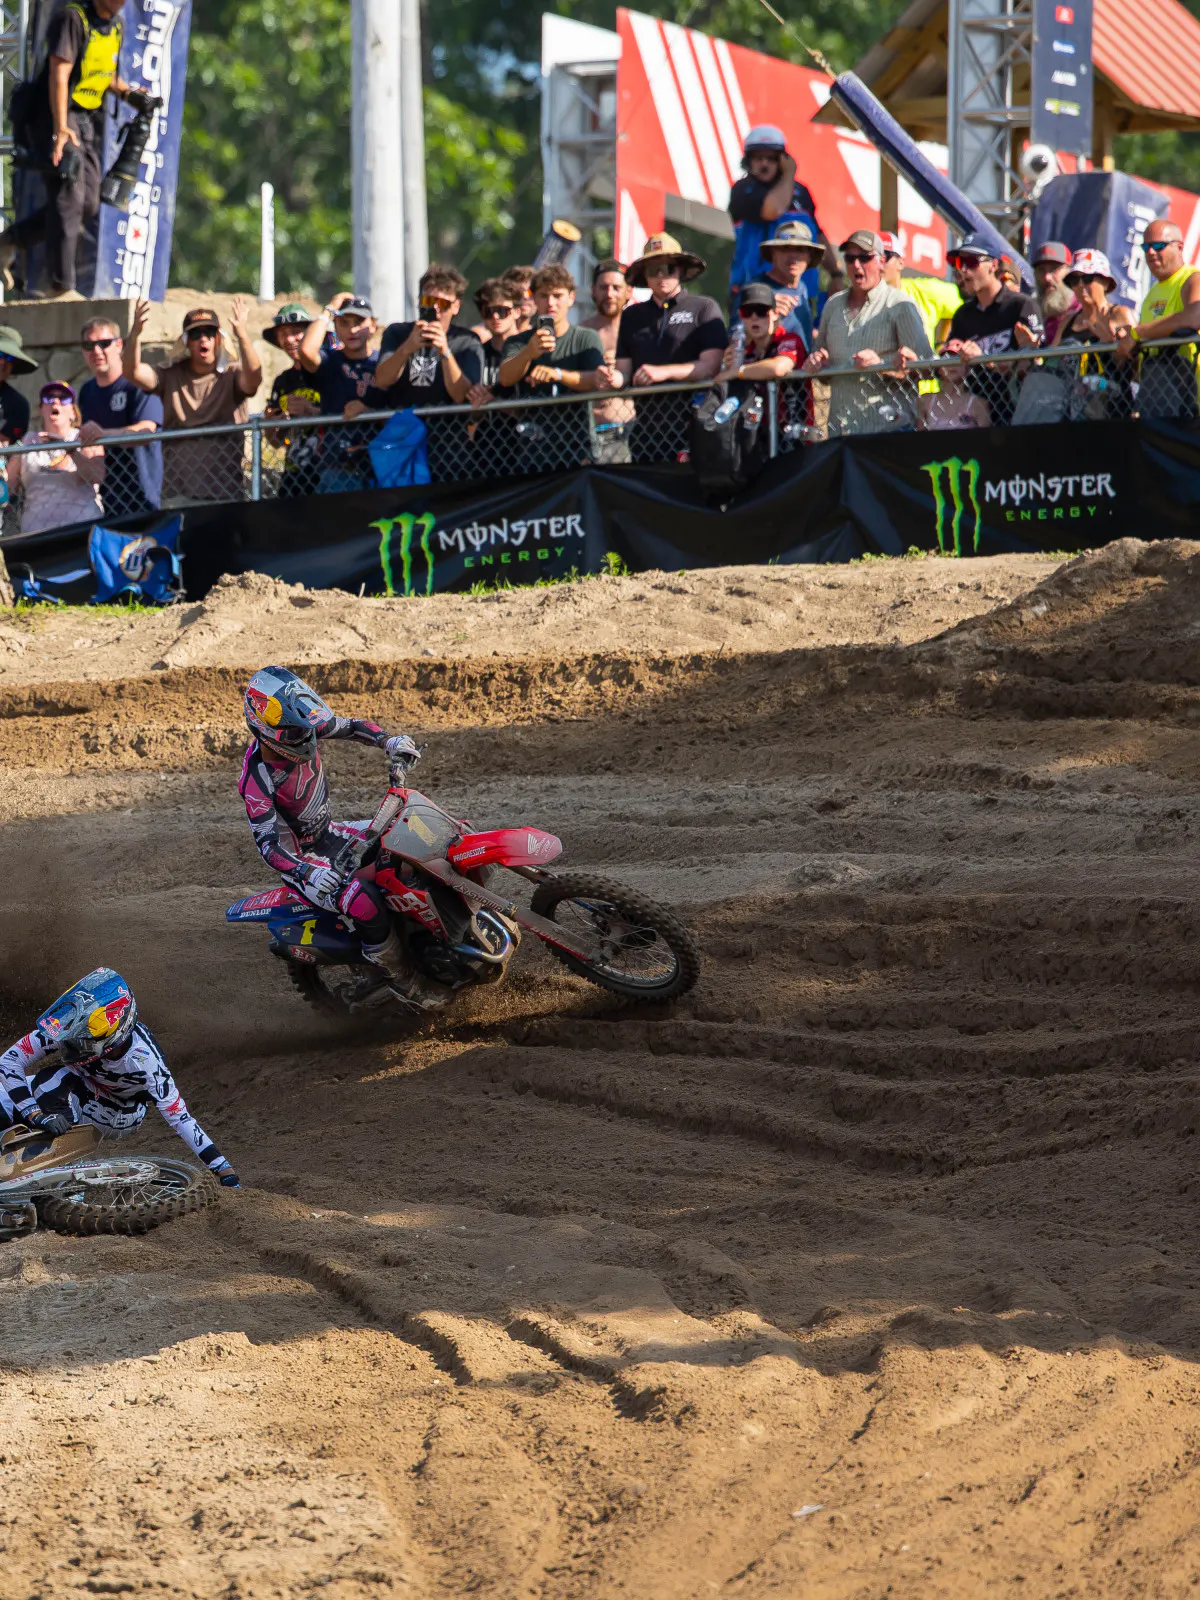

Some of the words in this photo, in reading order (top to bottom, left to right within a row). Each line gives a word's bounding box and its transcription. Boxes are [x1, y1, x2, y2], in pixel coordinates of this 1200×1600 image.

[984, 472, 1116, 506] MONSTER
[1005, 506, 1097, 522] ENERGY
[438, 513, 586, 552] MONSTER
[463, 547, 565, 568] ENERGY
[452, 845, 487, 862] PROGRESSIVE
[468, 890, 504, 913] SHOWA
[240, 908, 272, 918] DUNLOP
[300, 919, 318, 945] 1
